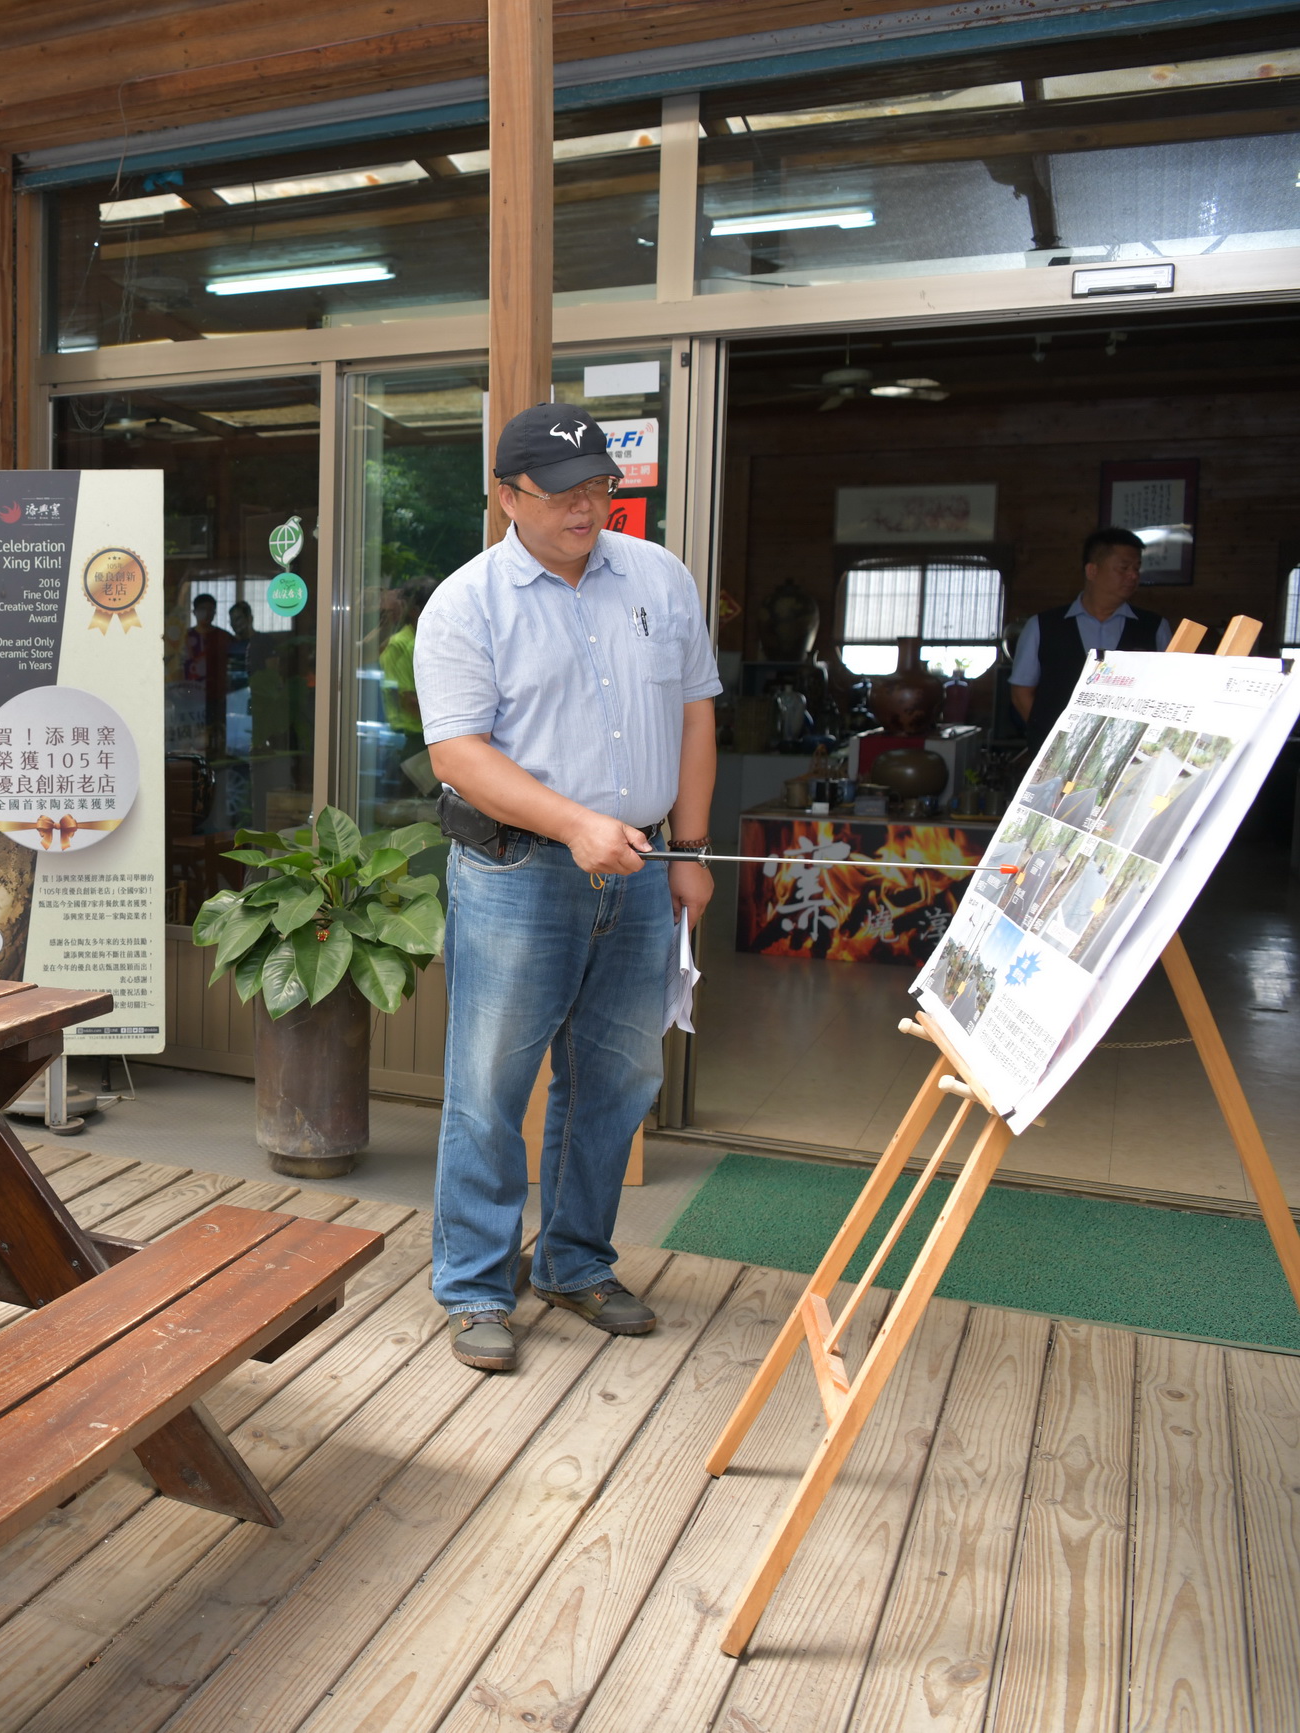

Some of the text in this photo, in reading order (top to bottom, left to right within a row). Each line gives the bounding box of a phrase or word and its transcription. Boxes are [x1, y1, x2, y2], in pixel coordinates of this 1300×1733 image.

[604, 430, 645, 449] i-Fi
[2, 556, 31, 572] Xing
[34, 556, 62, 569] Kiln!
[38, 578, 61, 588] 2016
[102, 582, 127, 596] 老店
[23, 590, 60, 599] Fine Old
[33, 602, 59, 611] Store
[28, 613, 58, 623] Award
[15, 637, 32, 647] and
[33, 637, 55, 649] Only
[30, 649, 54, 659] Store
[18, 661, 53, 671] in Years
